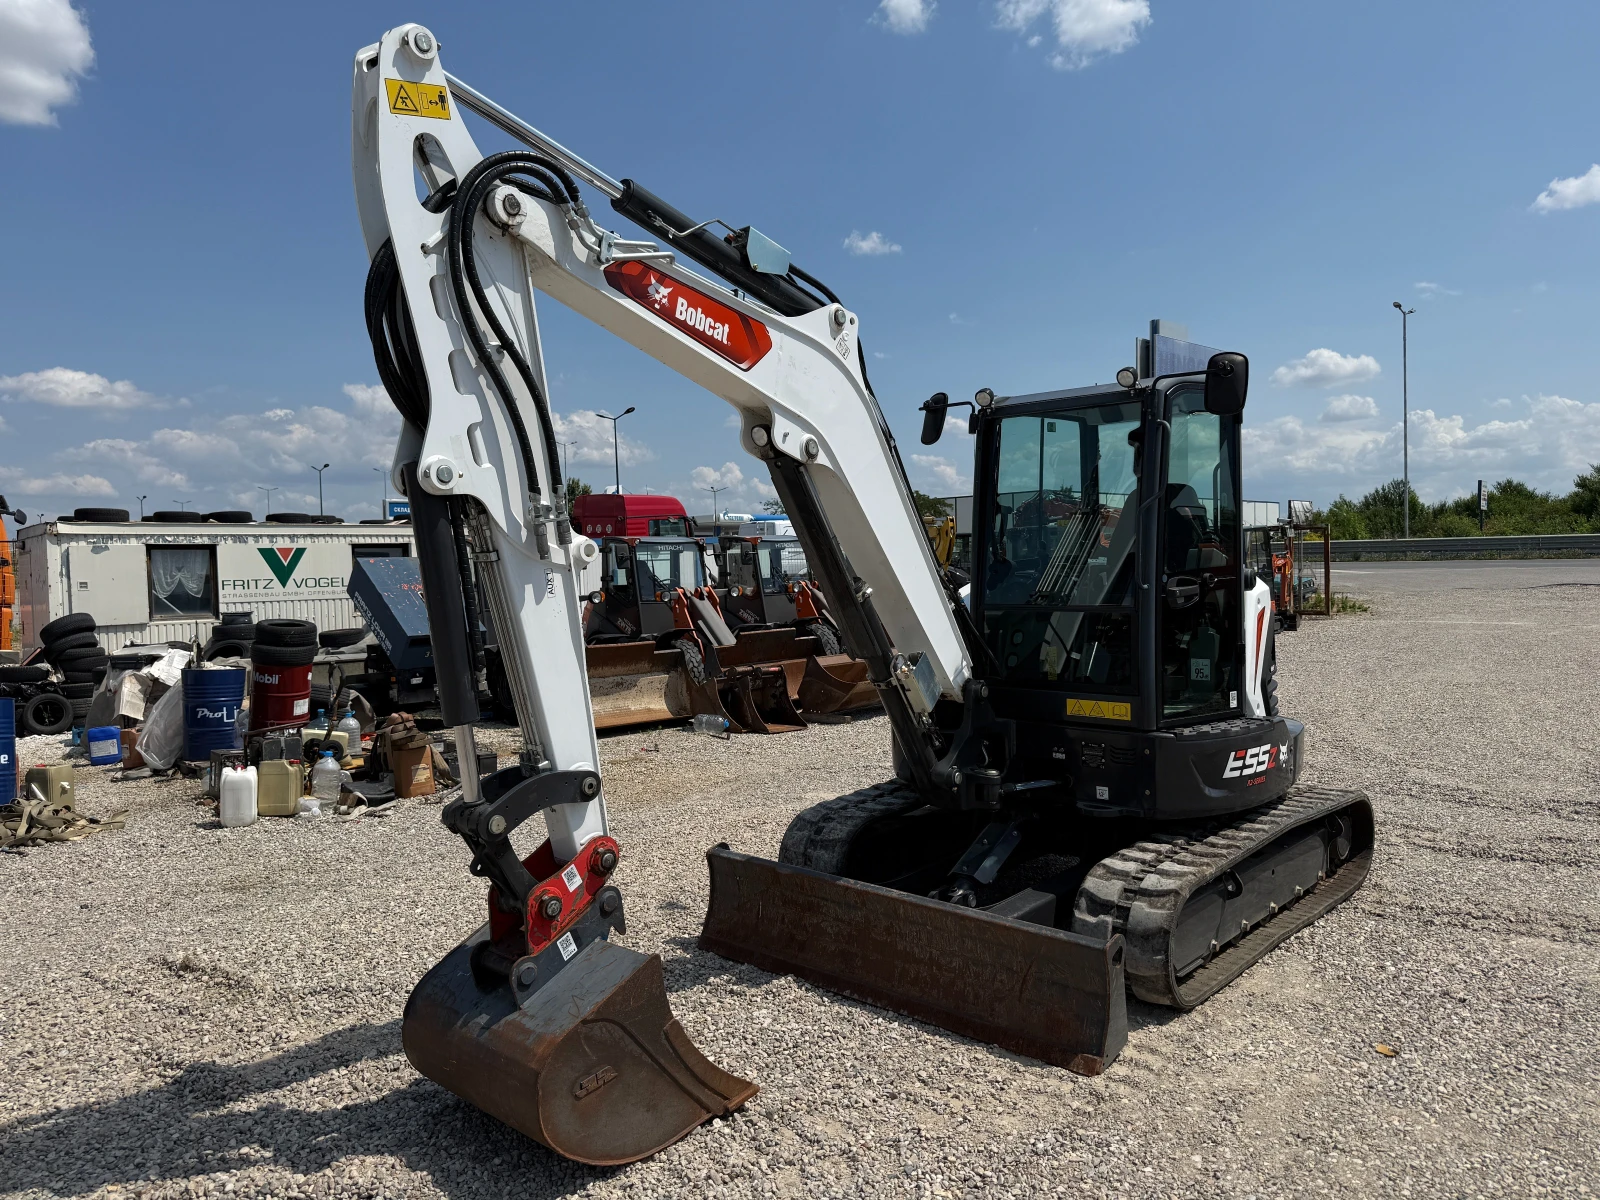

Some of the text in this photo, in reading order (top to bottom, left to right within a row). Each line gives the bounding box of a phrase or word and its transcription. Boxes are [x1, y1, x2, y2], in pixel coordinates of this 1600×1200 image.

[675, 296, 729, 345] Bobcat
[221, 576, 349, 591] FRITZ VOGEL
[546, 577, 555, 595] AUX
[222, 591, 280, 599] STRASSENBAU
[307, 588, 347, 596] OFFENBUR
[253, 671, 279, 685] Mobil
[1194, 667, 1205, 679] 95
